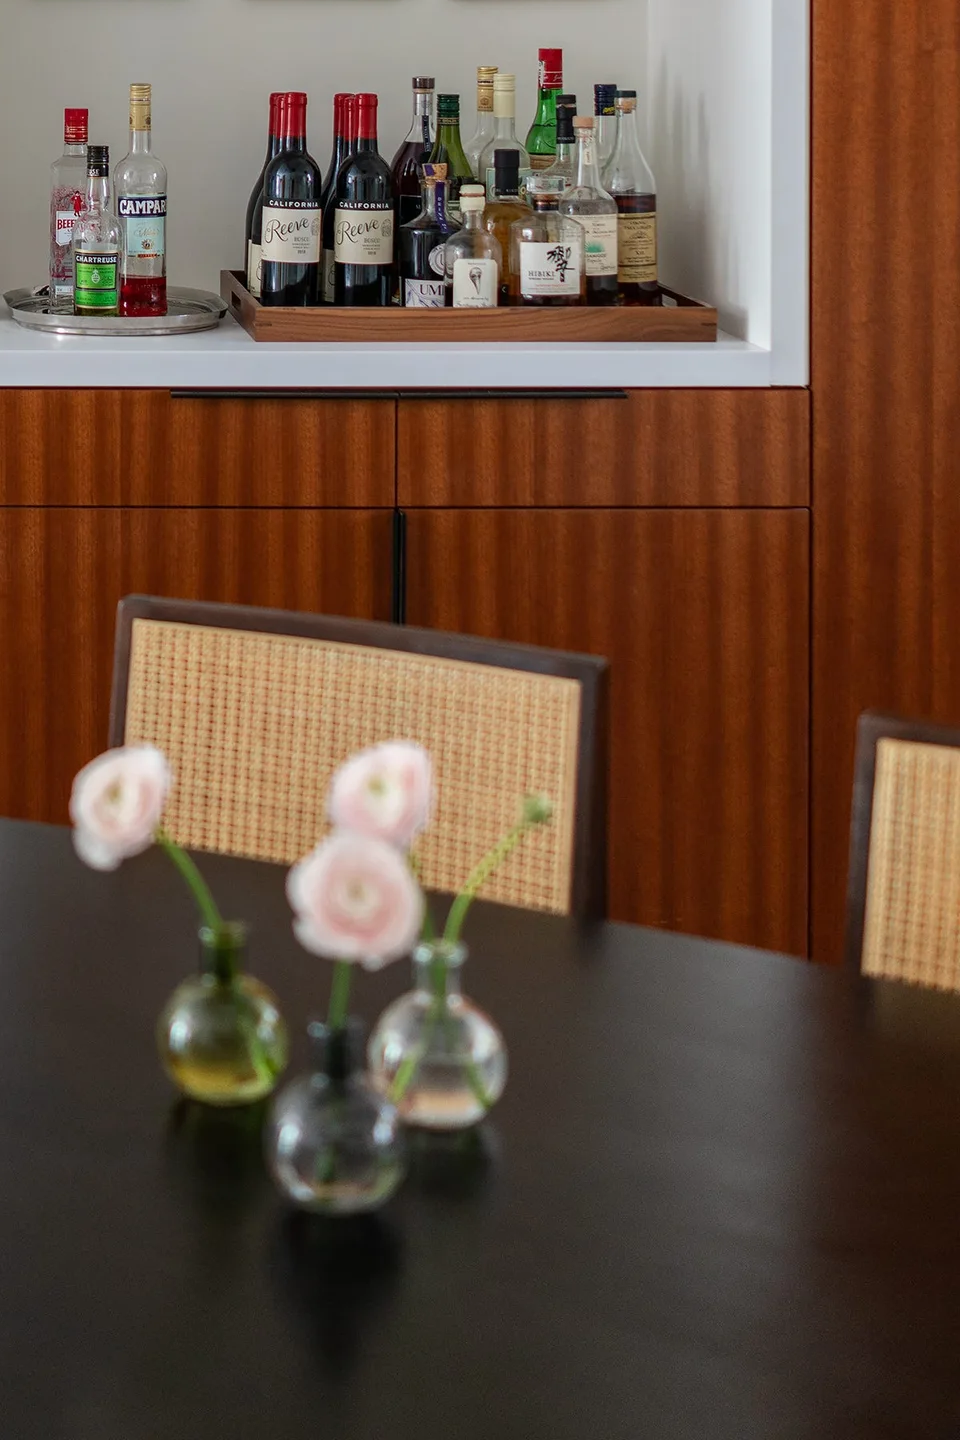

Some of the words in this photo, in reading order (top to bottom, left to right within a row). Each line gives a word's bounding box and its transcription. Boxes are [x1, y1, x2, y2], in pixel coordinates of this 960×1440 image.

[120, 198, 167, 215] CAMPAR
[269, 199, 319, 209] CALIFORNIA
[339, 201, 389, 210] CALIFORNIA
[265, 217, 310, 244] Reeve
[336, 219, 380, 246] Reeve
[76, 255, 117, 264] CHARTREUSE
[528, 270, 556, 278] HIBIKI
